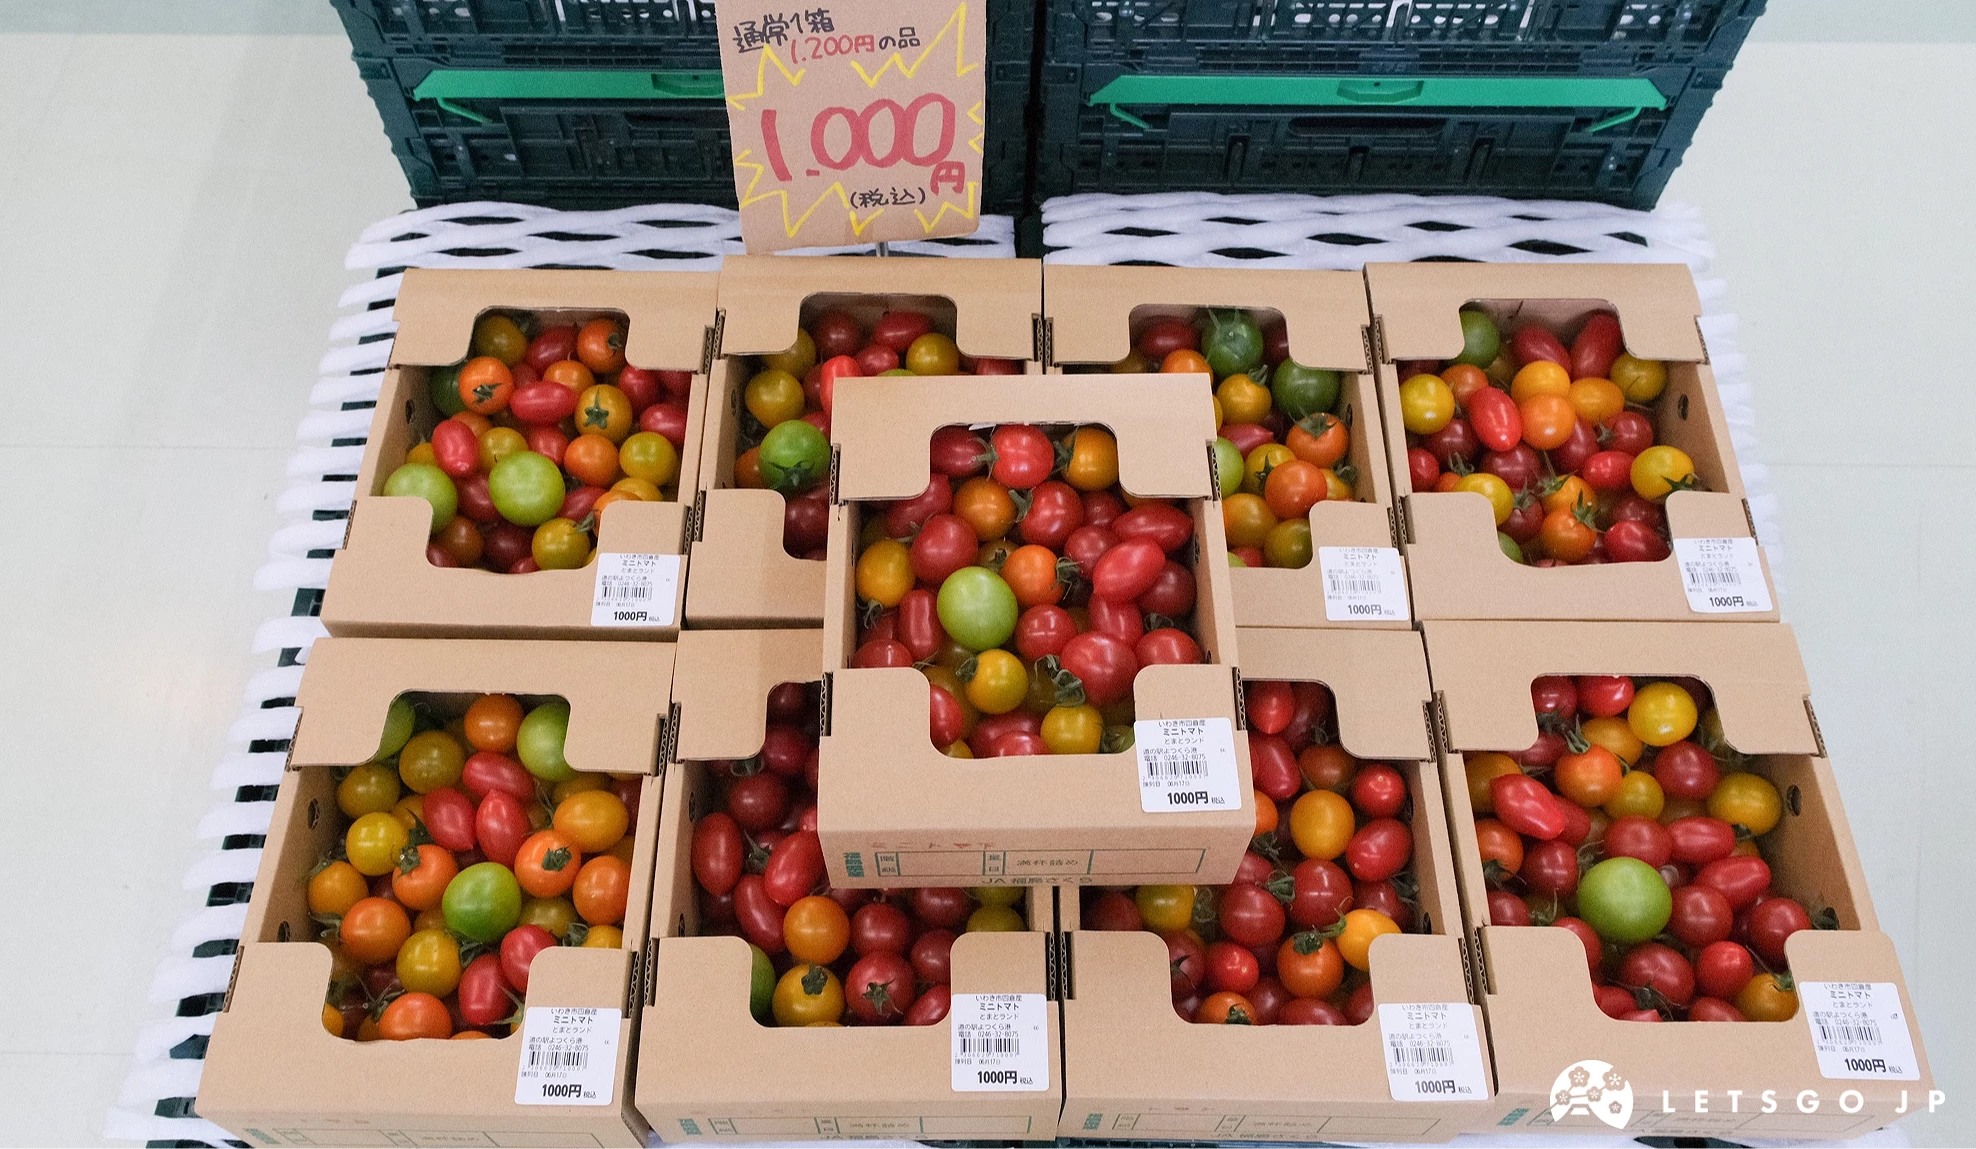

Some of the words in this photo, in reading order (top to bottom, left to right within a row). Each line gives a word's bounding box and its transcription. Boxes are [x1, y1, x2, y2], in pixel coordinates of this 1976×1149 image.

[734, 9, 836, 54] 通常1箱
[1709, 596, 1745, 608] 1000円
[1348, 605, 1383, 616] 1000円
[614, 611, 648, 622] 1000円
[1163, 728, 1205, 737] ミニトマト
[1167, 791, 1209, 805] 1000円
[1830, 991, 1872, 1000] ミニトマト
[980, 1003, 1020, 1012] ミニトマト
[554, 1016, 594, 1025] ミニトマト
[1407, 1012, 1448, 1021] ミニトマト
[1845, 1058, 1887, 1074] 1000円
[978, 1071, 1018, 1085] 1000円
[542, 1084, 583, 1099] 1000円
[1415, 1080, 1457, 1095] 1000円
